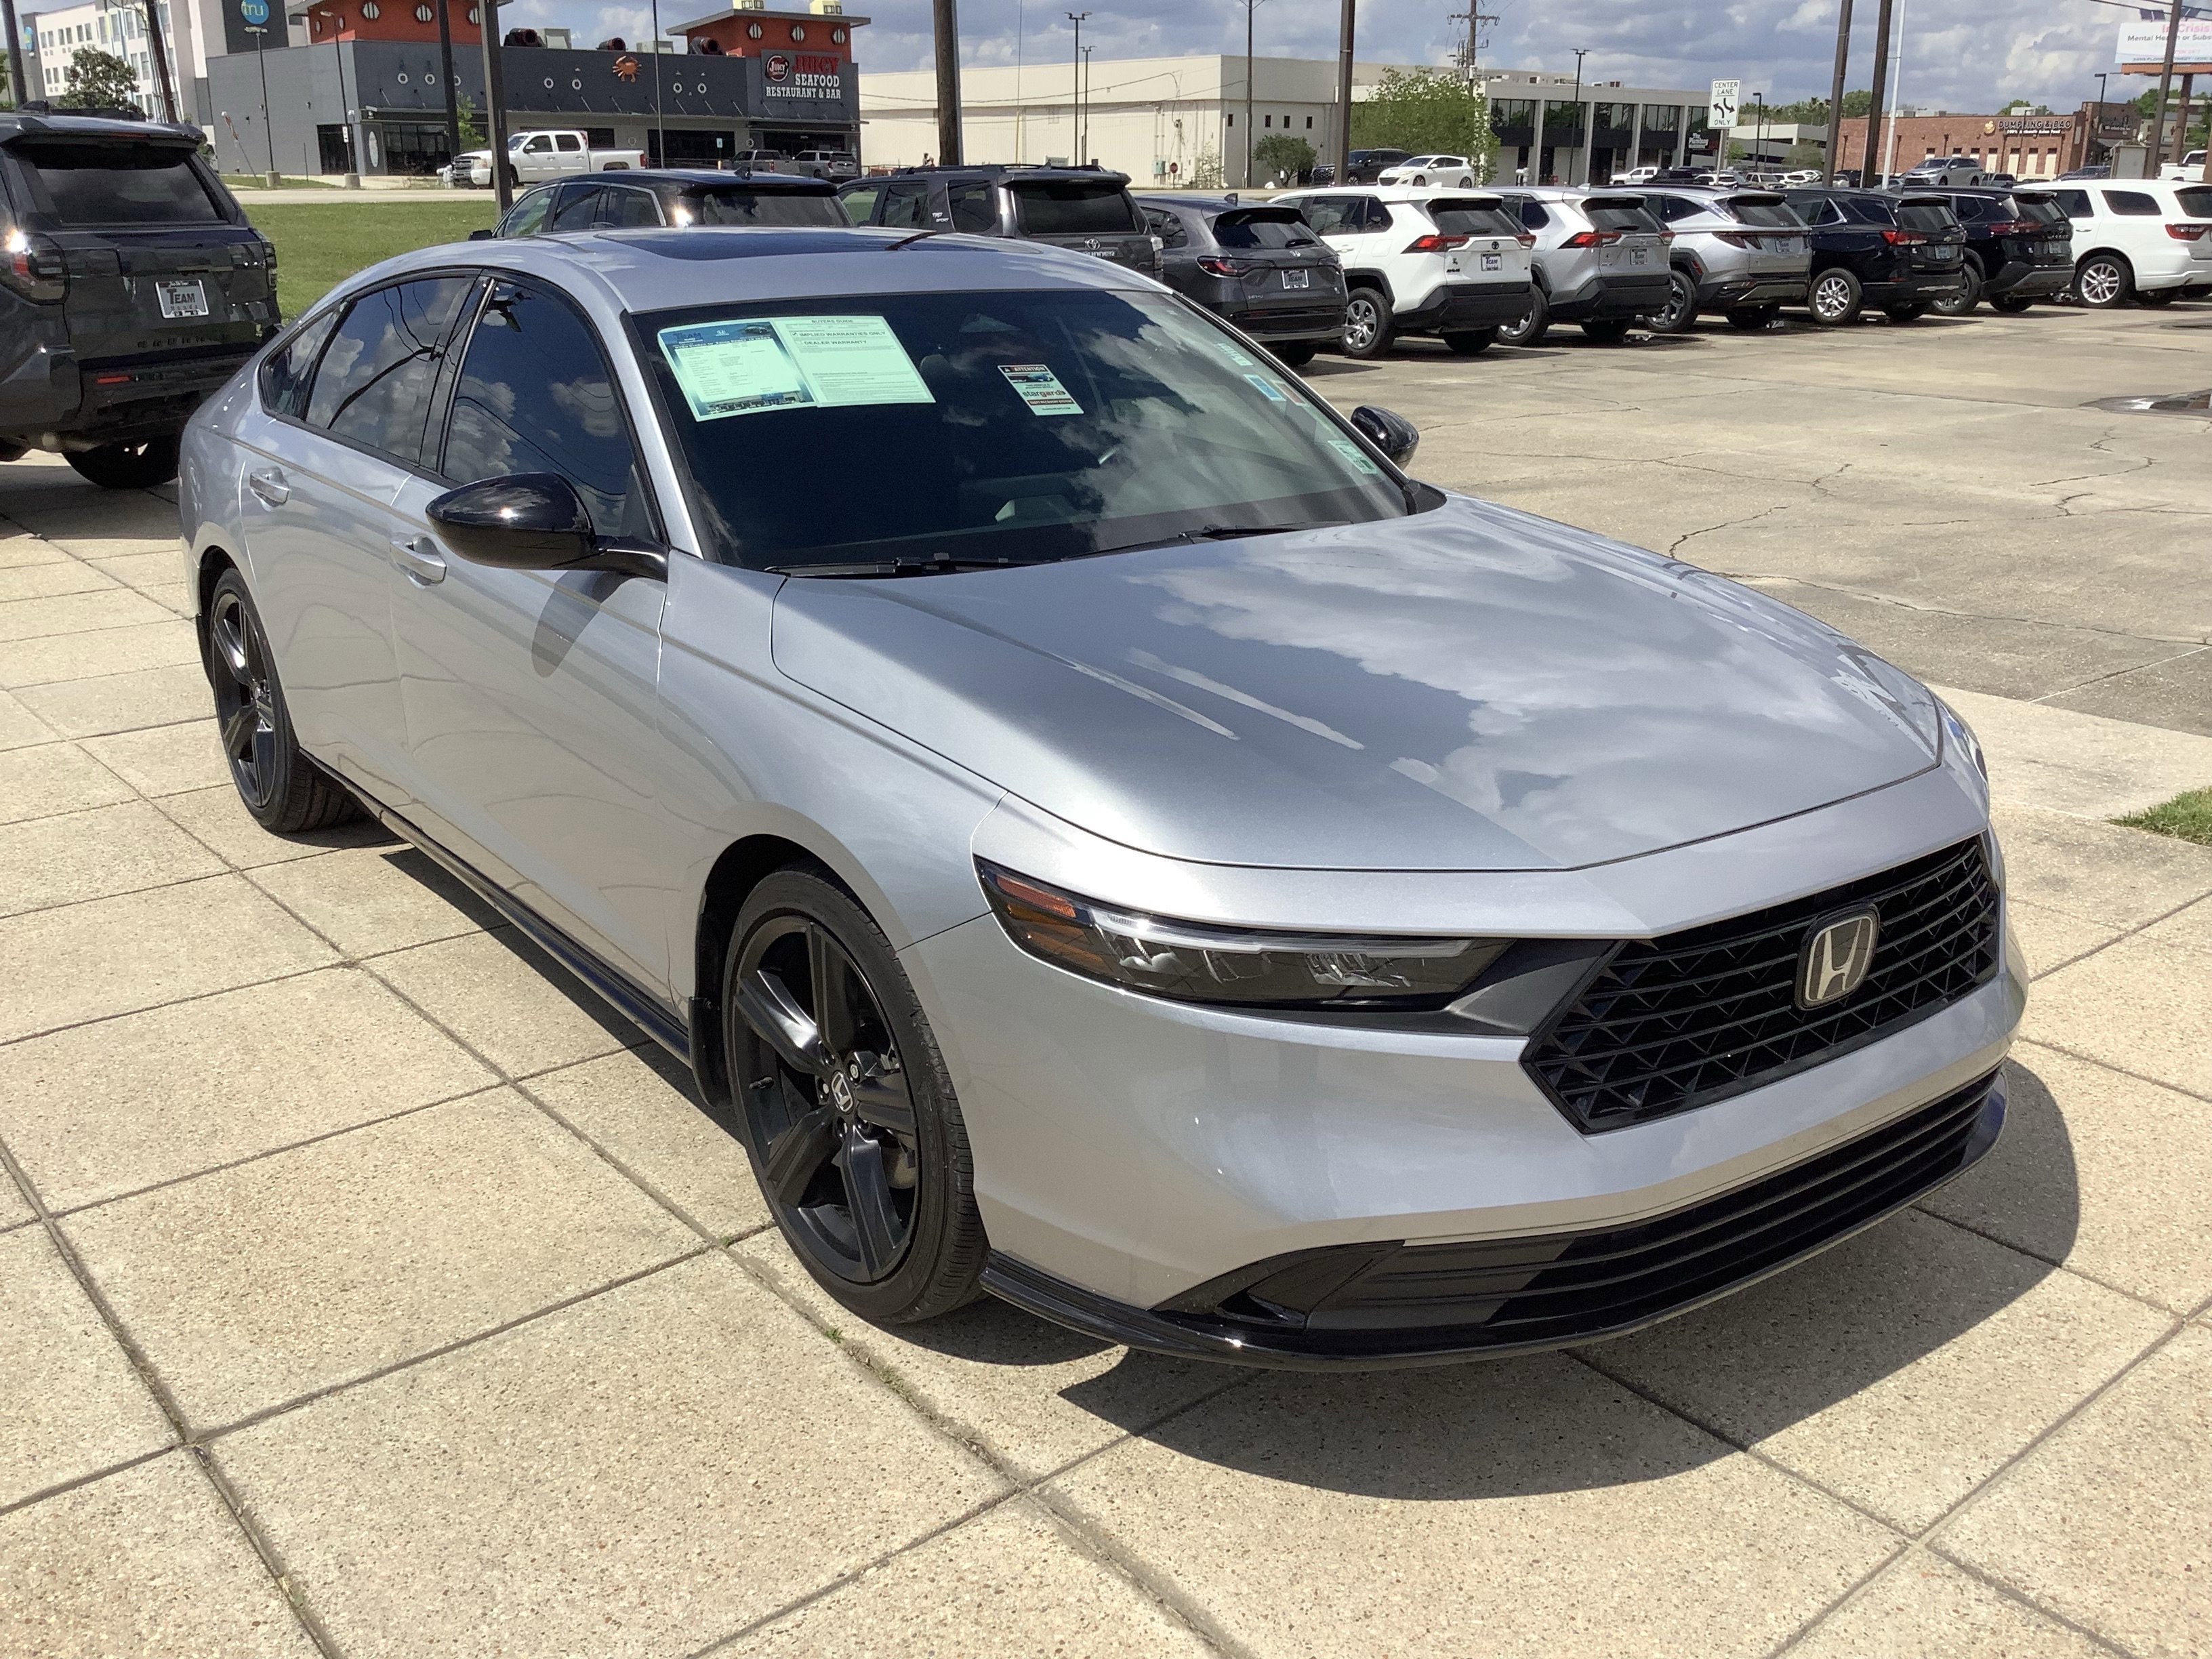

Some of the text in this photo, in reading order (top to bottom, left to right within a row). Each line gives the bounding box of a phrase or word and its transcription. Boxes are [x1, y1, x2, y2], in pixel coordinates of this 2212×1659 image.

[792, 55, 840, 74] JUICY
[795, 73, 840, 87] SEAFOOD
[766, 86, 841, 99] RESTAURANT & BAR
[2044, 121, 2051, 129] &
[2052, 121, 2072, 129] BAO
[166, 289, 195, 304] TEAM
